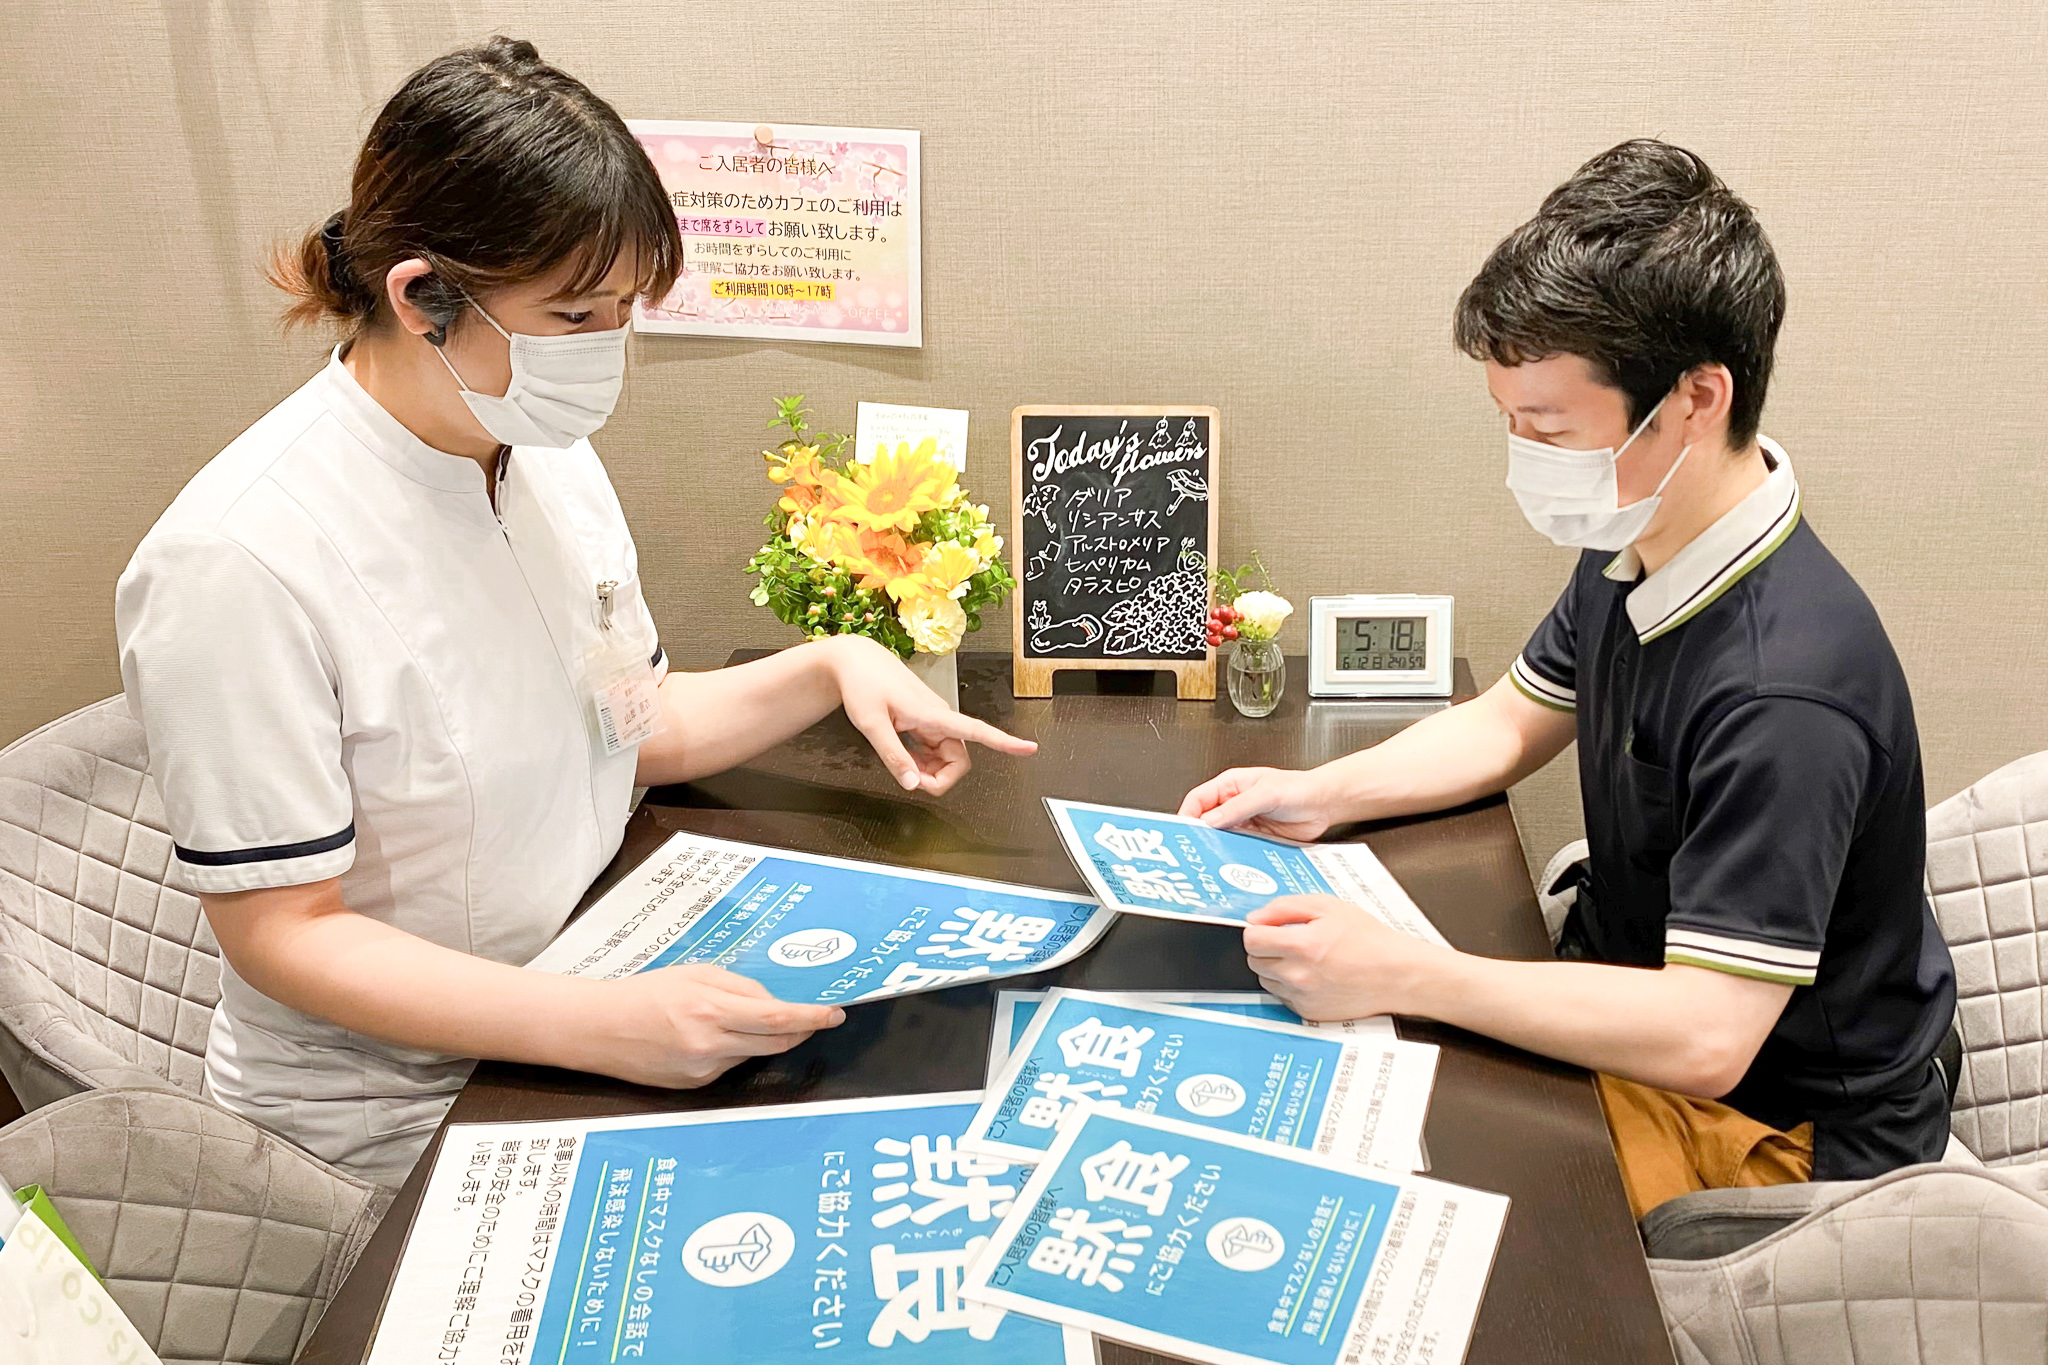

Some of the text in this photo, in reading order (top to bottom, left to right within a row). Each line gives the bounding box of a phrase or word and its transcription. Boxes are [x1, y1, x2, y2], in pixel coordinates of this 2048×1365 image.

[698, 155, 834, 176] ご入居者の皆様へ
[669, 190, 903, 217] 症対策のためカフェのご利用は
[676, 217, 887, 244] まで席をずらしてお願い致します。
[685, 261, 862, 281] ご理解ご協力をお願い致します。
[694, 242, 851, 261] お時間をずらしてのご利用に
[838, 306, 891, 321] COFFEE
[1027, 420, 1144, 482] Today's
[1111, 443, 1208, 487] flowers
[1065, 488, 1132, 509] ダリア
[1068, 509, 1162, 533] リシアンサス
[1065, 534, 1171, 555] アルストロメリア
[1063, 576, 1142, 596] タラスピ
[1355, 620, 1414, 651] 5:18
[690, 852, 740, 887] 致します。
[1092, 821, 1209, 908] 黙食
[599, 855, 757, 981] 食事以外の時間はマスクの着用をお
[813, 905, 934, 1001] にご協力ください
[985, 1055, 1045, 1139] ご入居者の皆様へ
[1246, 1052, 1288, 1137] マスクなしの会話で
[451, 1140, 495, 1212] い致します。
[513, 1138, 551, 1196] 致します。
[989, 1187, 1064, 1287] ご入居者の皆様へ
[1026, 1139, 1192, 1294] 黙食
[1145, 1163, 1223, 1296] にご協力ください
[574, 1167, 633, 1346] 飛沫感染しないために！
[620, 1156, 677, 1357] 食事中マスクなしの会話で
[811, 1150, 847, 1349] にご協力ください
